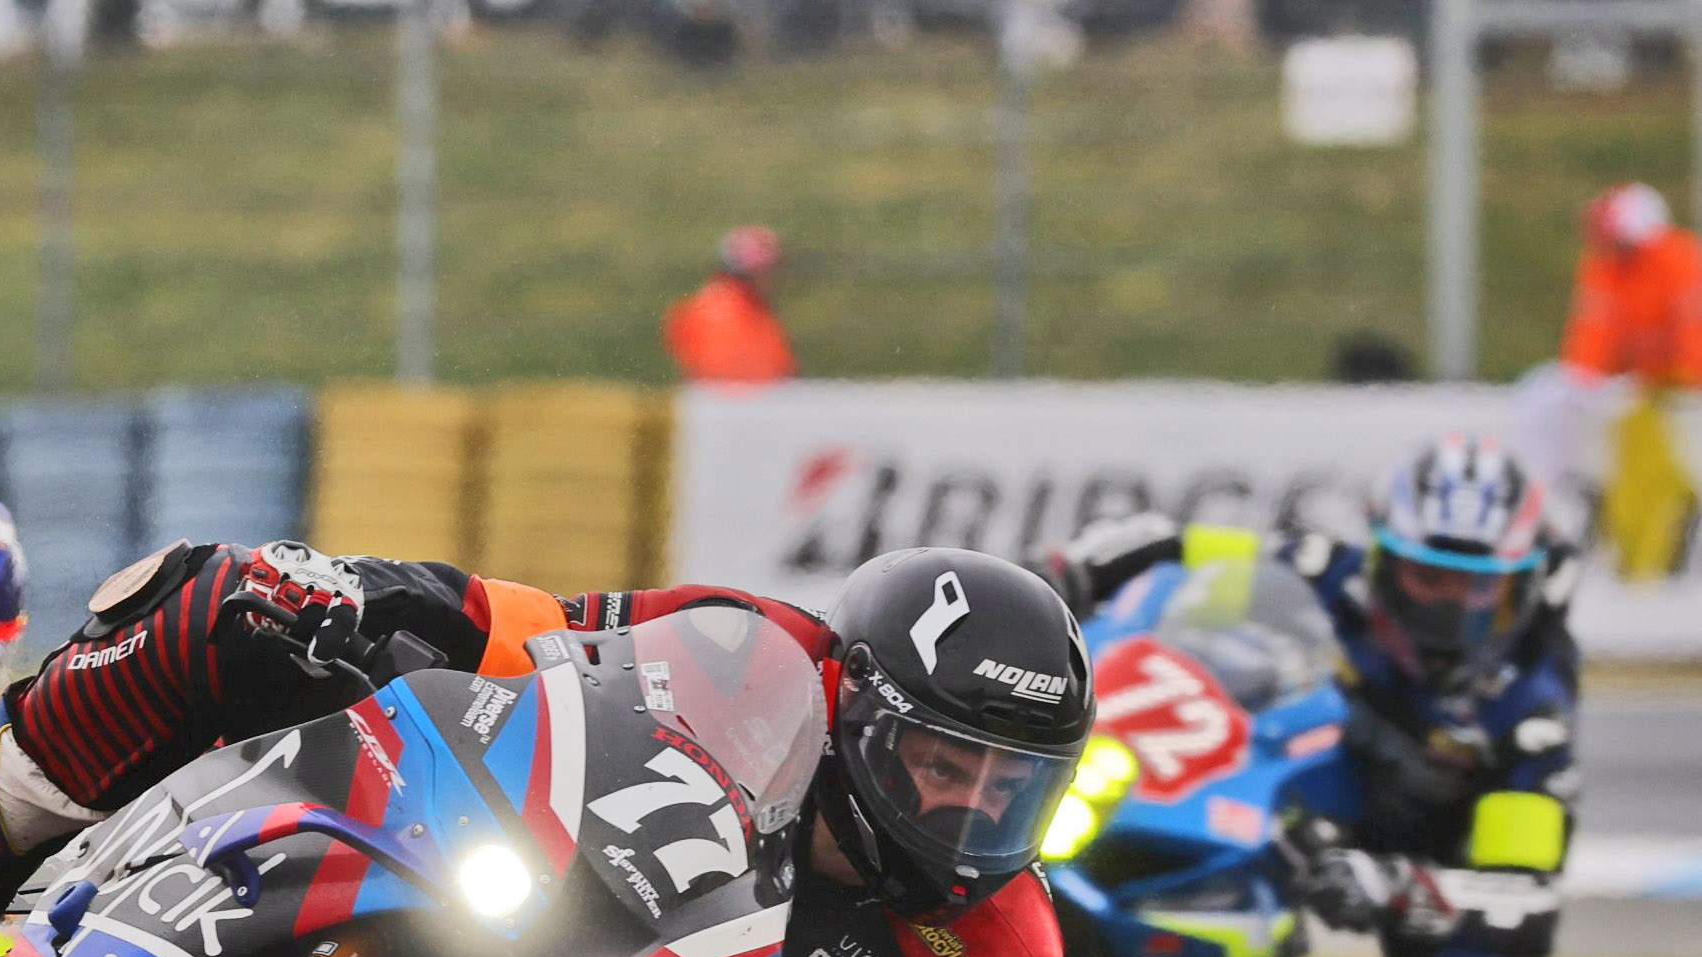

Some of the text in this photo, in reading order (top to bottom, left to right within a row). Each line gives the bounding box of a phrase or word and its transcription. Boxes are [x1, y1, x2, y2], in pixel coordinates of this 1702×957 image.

[67, 629, 149, 671] DAMEN
[868, 671, 914, 714] X-804
[973, 658, 1068, 704] NOLAN
[473, 682, 518, 735] Diverse
[1094, 653, 1228, 777] 72
[586, 746, 749, 894] 77
